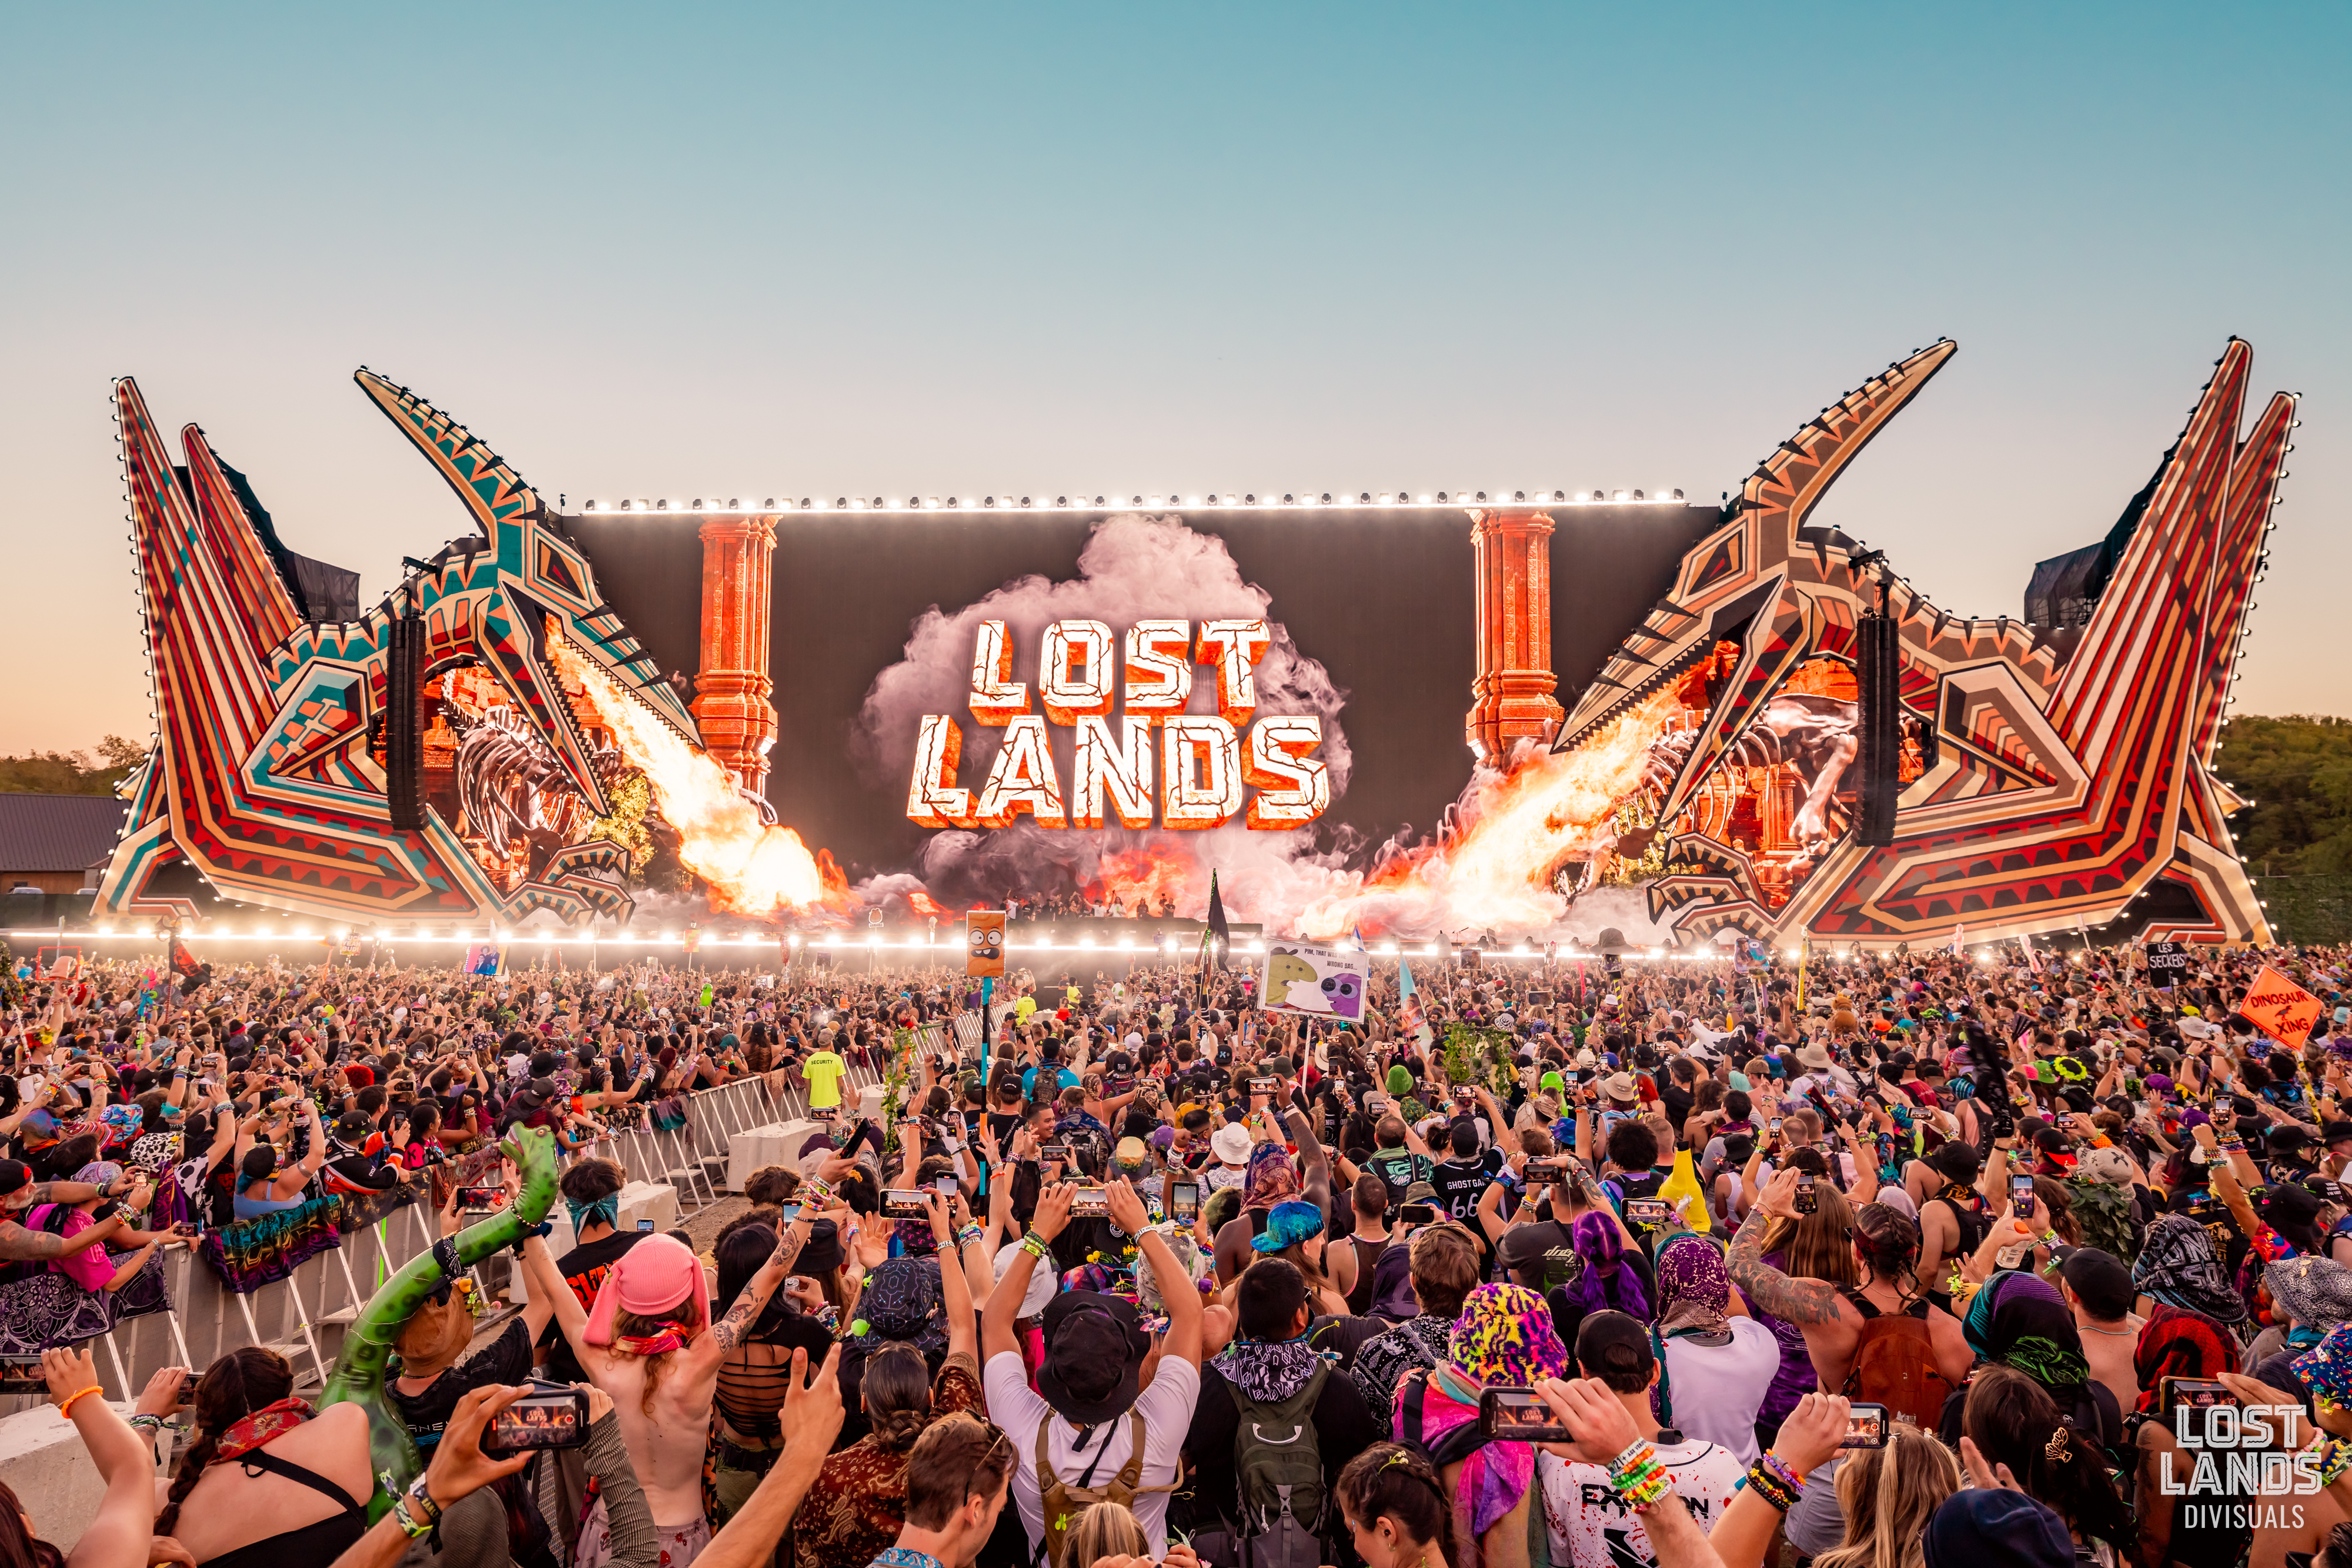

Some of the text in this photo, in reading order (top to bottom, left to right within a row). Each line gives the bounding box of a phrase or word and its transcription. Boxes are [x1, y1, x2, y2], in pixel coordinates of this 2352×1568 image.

[969, 619, 1270, 726] LOST
[906, 714, 1331, 830] LANDS
[1327, 951, 1337, 959] WAS
[2158, 942, 2173, 953] LES
[1327, 960, 1344, 968] WRONG
[2250, 991, 2308, 1008] DINOSAUR
[2274, 1018, 2308, 1035] XING
[1001, 1118, 1019, 1145] SUPREME
[1447, 1179, 1472, 1189] GHOST
[1451, 1192, 1479, 1218] 66
[1613, 1455, 1626, 1470] 21+
